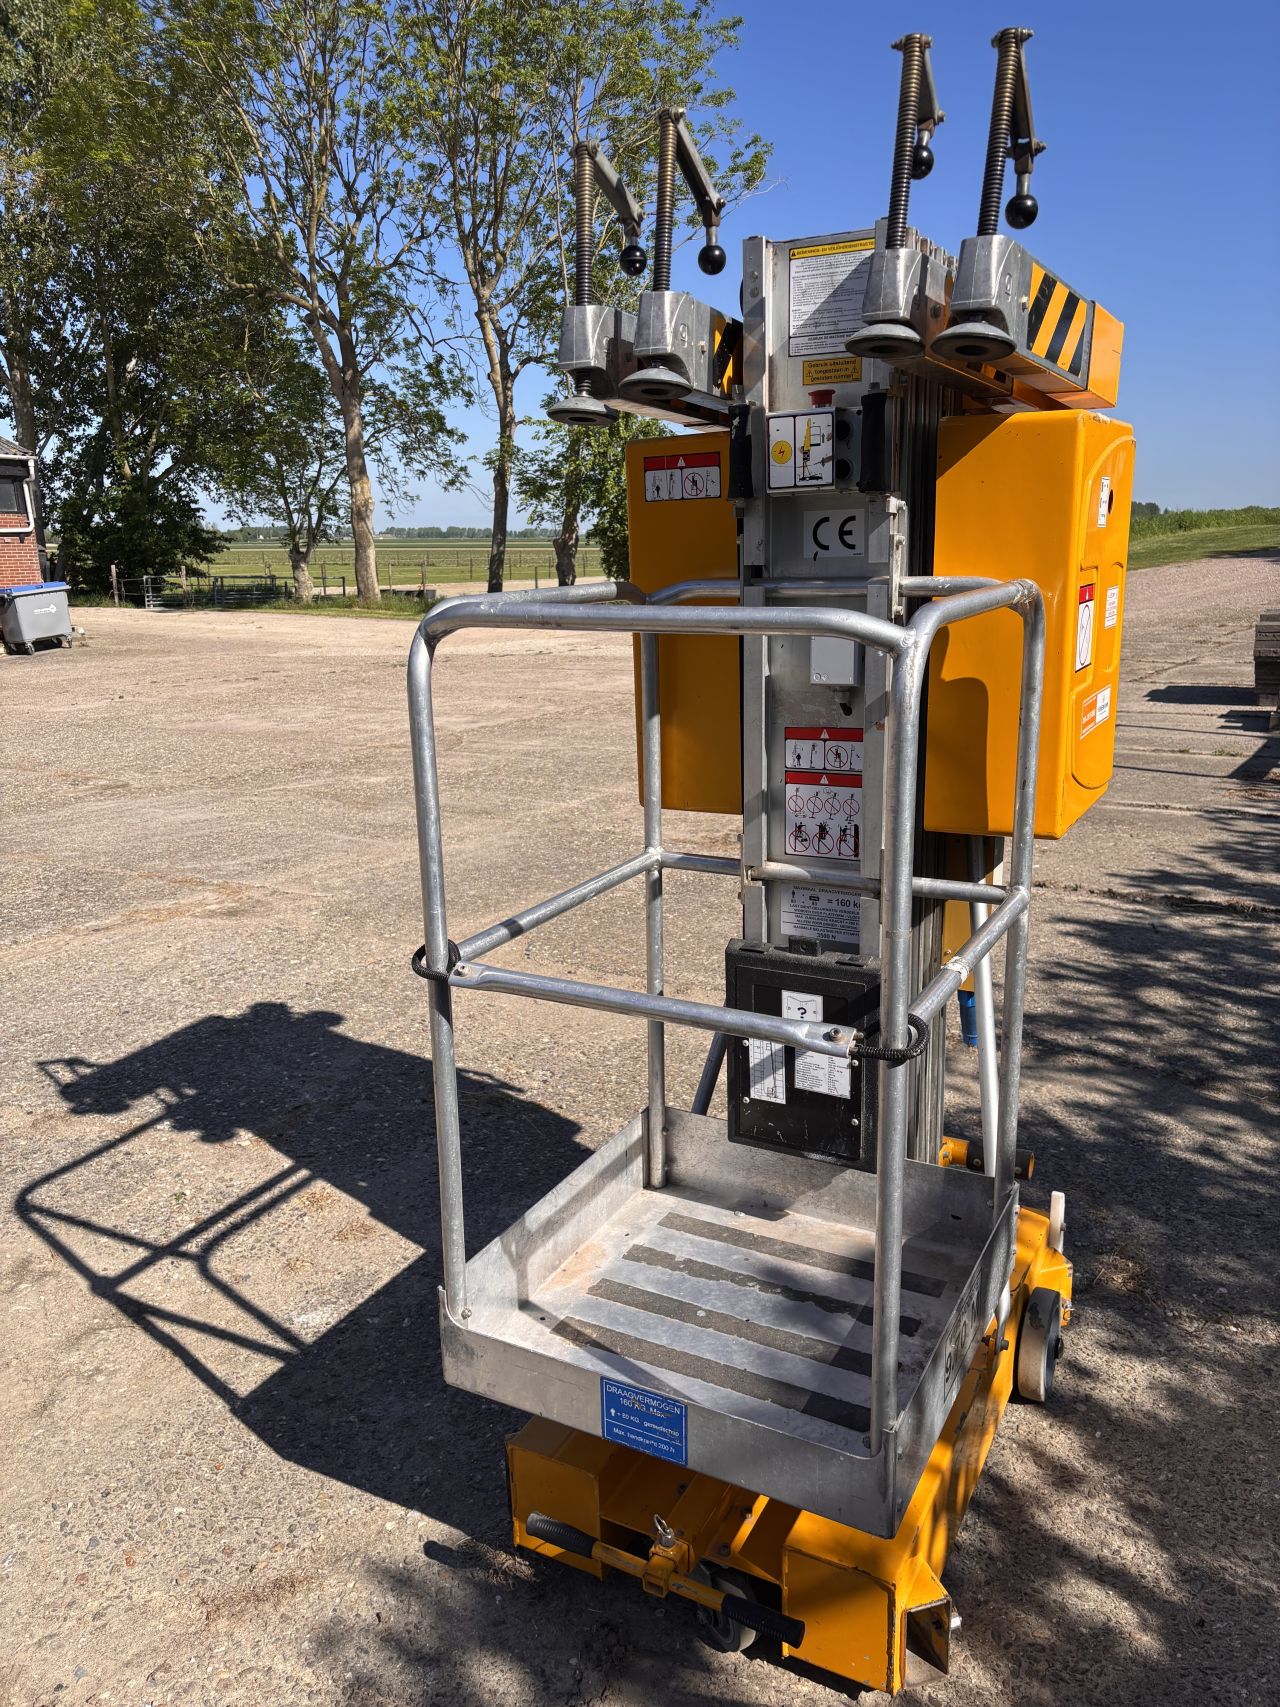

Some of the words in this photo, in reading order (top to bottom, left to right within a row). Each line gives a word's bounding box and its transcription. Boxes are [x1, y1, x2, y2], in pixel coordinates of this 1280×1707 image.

[812, 516, 856, 550] CE
[834, 898, 851, 908] 160
[606, 1384, 680, 1414] DRAAGVERMOGEN
